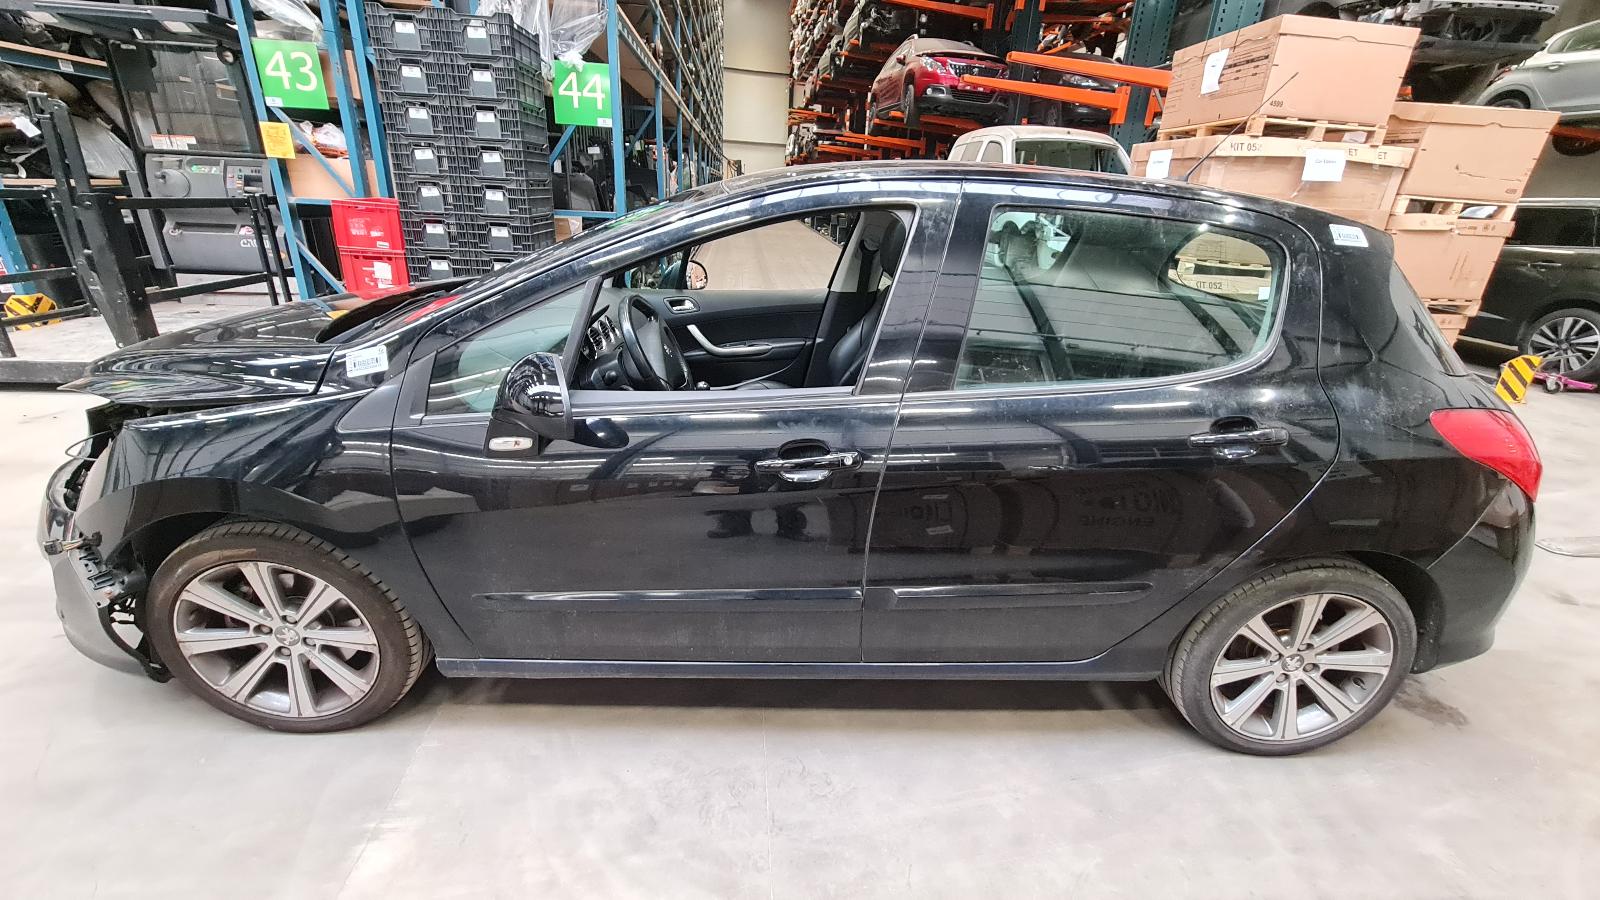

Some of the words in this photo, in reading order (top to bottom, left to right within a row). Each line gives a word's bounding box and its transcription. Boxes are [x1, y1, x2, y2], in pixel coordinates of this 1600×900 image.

[265, 50, 318, 92] 43
[558, 71, 606, 111] 44
[1230, 142, 1245, 152] KIT
[1208, 281, 1223, 290] 052
